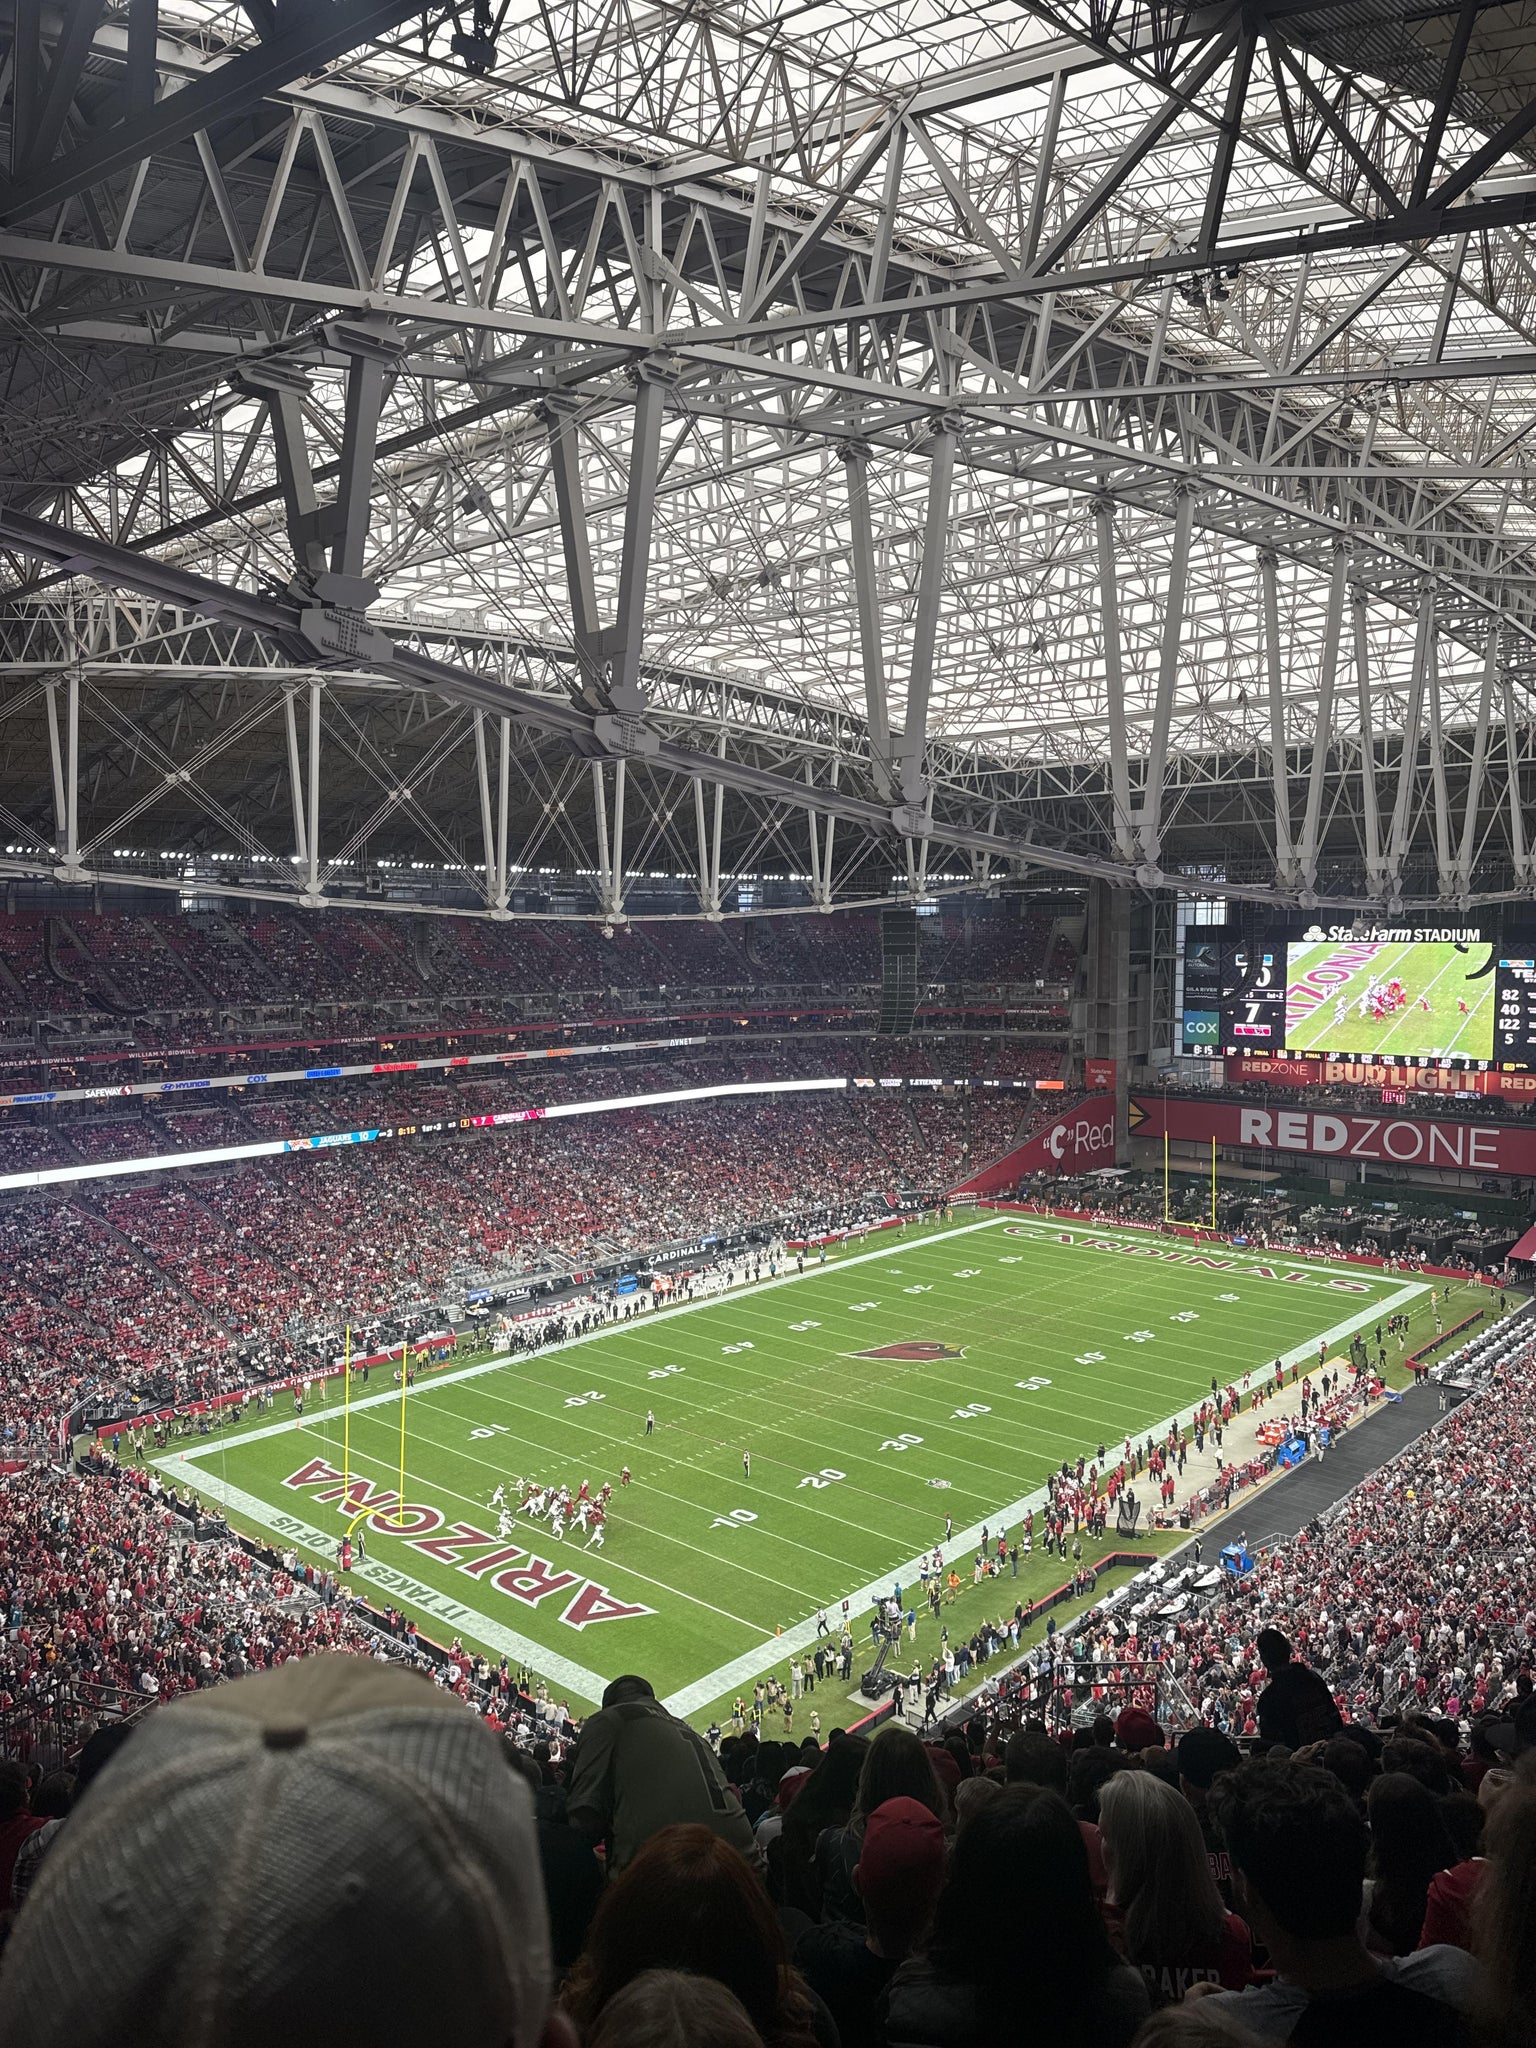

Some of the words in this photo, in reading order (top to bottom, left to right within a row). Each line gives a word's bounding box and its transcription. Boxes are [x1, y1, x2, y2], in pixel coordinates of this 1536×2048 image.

[1328, 926, 1411, 941] StaeFarm
[1414, 929, 1480, 942] STADIUM
[1502, 990, 1519, 1000] 82
[1246, 1003, 1260, 1023] 7
[1500, 1004, 1520, 1014] 40
[1186, 1022, 1217, 1034] COX
[1499, 1018, 1520, 1030] 122
[1505, 1034, 1514, 1044] 5
[1242, 1062, 1308, 1076] REDZONE
[247, 1075, 267, 1083] COX
[1327, 1063, 1386, 1084] BUD
[1391, 1068, 1480, 1090] LIGHT
[176, 1080, 210, 1089] HYUNDAI
[85, 1090, 122, 1098] SAFEWAY
[320, 1133, 352, 1142] JAGUARS
[398, 1127, 416, 1135] 8:15
[1075, 1115, 1114, 1154] Red
[1240, 1108, 1500, 1170] REDZONE
[1120, 1221, 1156, 1230] CARDINALS
[648, 1244, 706, 1266] CARDINALS
[1268, 1244, 1302, 1253] ARIZOA
[1304, 1249, 1347, 1260] CARDNALS
[1002, 1226, 1376, 1293] CARDINALS
[848, 1302, 877, 1311] 40
[1169, 1312, 1200, 1322] 20
[788, 1320, 822, 1331] 50
[1123, 1331, 1155, 1342] 30
[721, 1342, 754, 1353] 40
[1074, 1353, 1106, 1365] 40
[290, 1368, 340, 1386] CARDINALS
[648, 1364, 686, 1378] 30
[1014, 1376, 1052, 1390] 50
[564, 1391, 606, 1406] 20
[954, 1403, 992, 1418] 40
[470, 1424, 510, 1438] 10
[882, 1433, 924, 1451] 30
[801, 1469, 846, 1489] 20
[270, 1516, 304, 1534] US
[713, 1509, 758, 1528] 10
[280, 1456, 660, 1631] ARIZONA
[296, 1532, 331, 1548] OF
[364, 1566, 440, 1606] TAKES
[434, 1604, 470, 1620] IT
[1206, 1852, 1232, 1880] BA
[1141, 1964, 1221, 2000] BAKER
